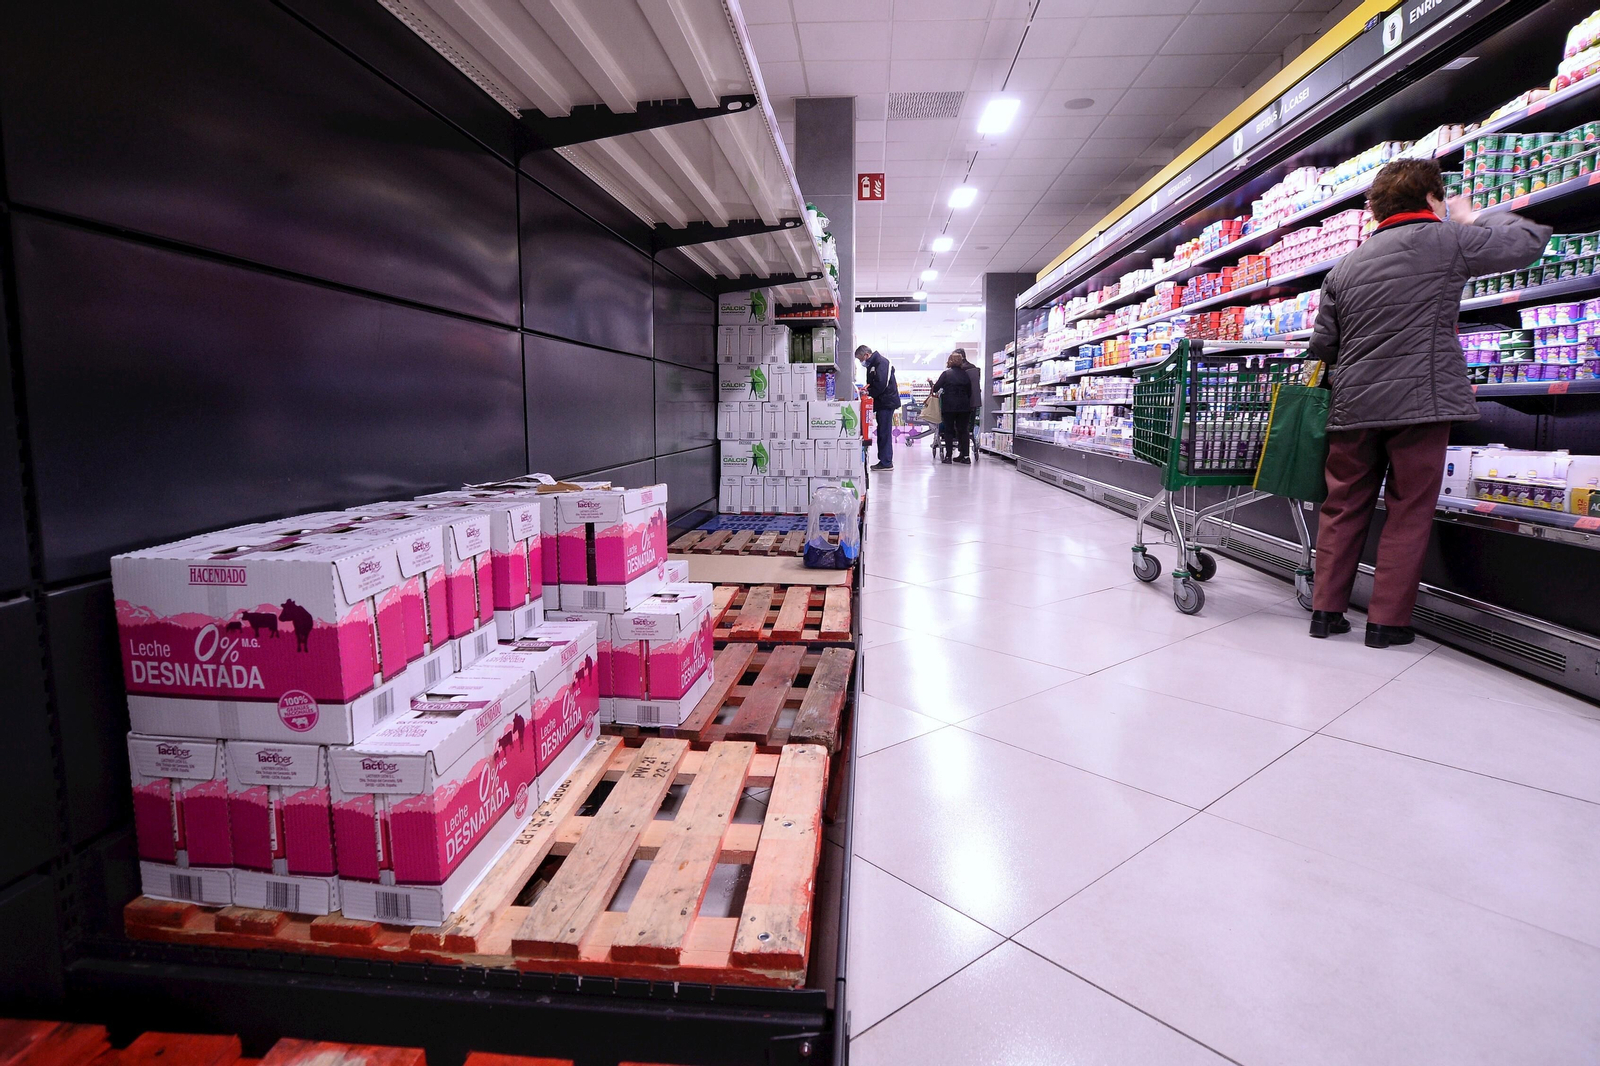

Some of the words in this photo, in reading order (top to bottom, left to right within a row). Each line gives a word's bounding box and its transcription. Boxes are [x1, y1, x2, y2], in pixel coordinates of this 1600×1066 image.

[189, 567, 246, 585] HACENDADO
[627, 549, 656, 575] DESNATADA
[129, 638, 171, 658] Leche
[194, 622, 240, 664] 0%
[241, 638, 261, 648] M.G.
[131, 661, 266, 690] DESNATADA
[283, 694, 309, 706] 100%
[475, 701, 502, 734] HACENDADO
[540, 718, 557, 740] Leche
[541, 706, 583, 762] DESNATADA
[479, 762, 500, 803] 0%
[444, 804, 470, 837] Leche
[445, 780, 511, 865] DESNATADA
